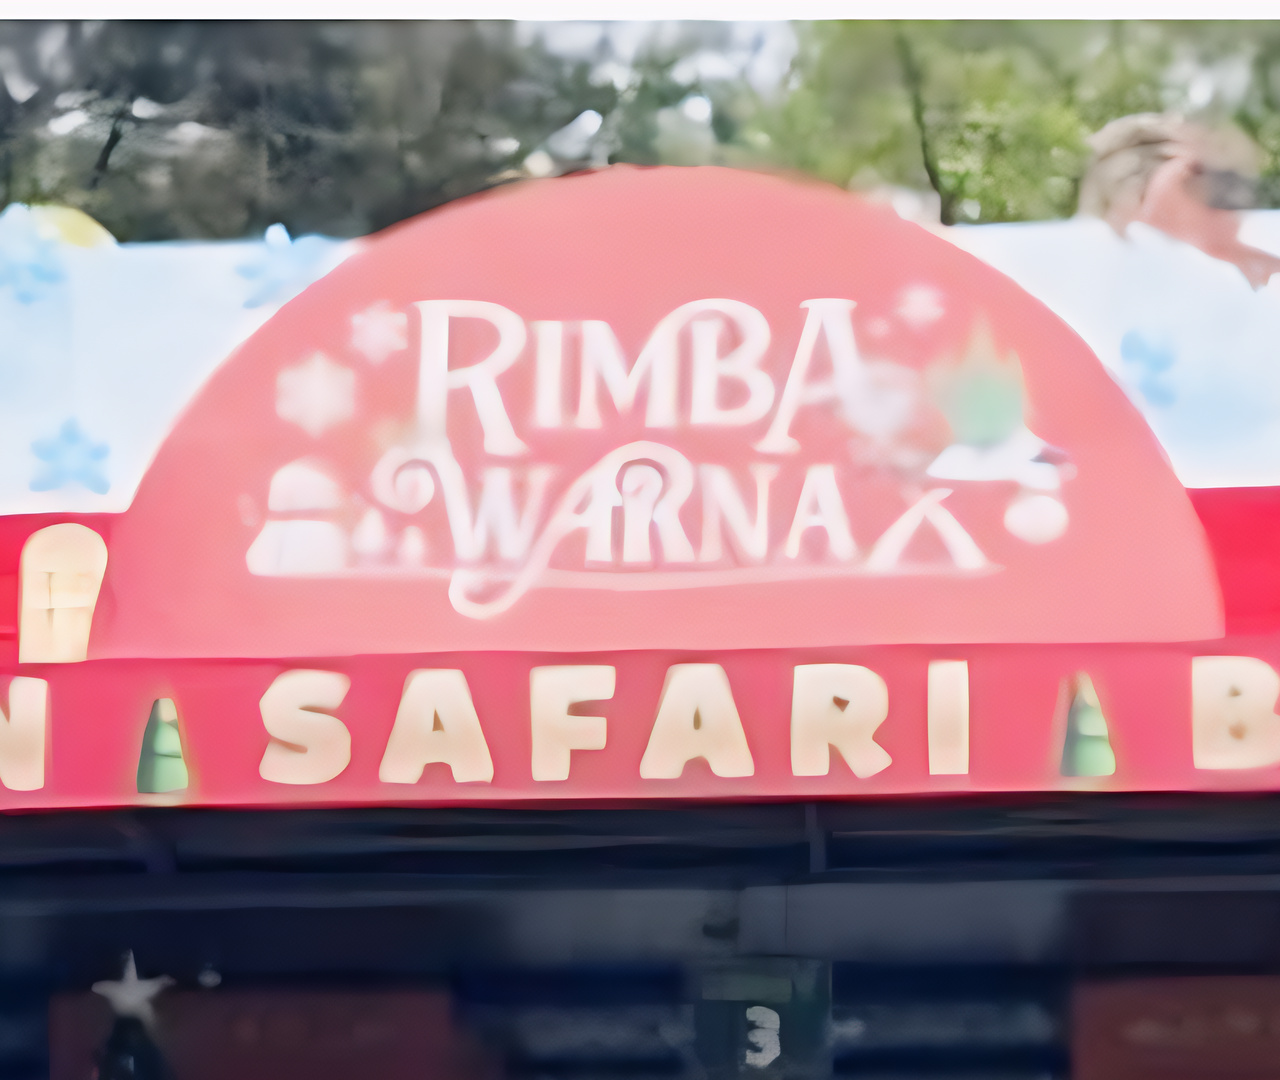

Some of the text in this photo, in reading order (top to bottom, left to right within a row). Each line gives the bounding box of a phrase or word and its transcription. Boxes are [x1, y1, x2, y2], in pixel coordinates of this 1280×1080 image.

[412, 297, 860, 455] RIMBA
[372, 441, 856, 619] WARNA
[257, 659, 970, 786] SAFARI
[744, 1004, 783, 1070] 3
